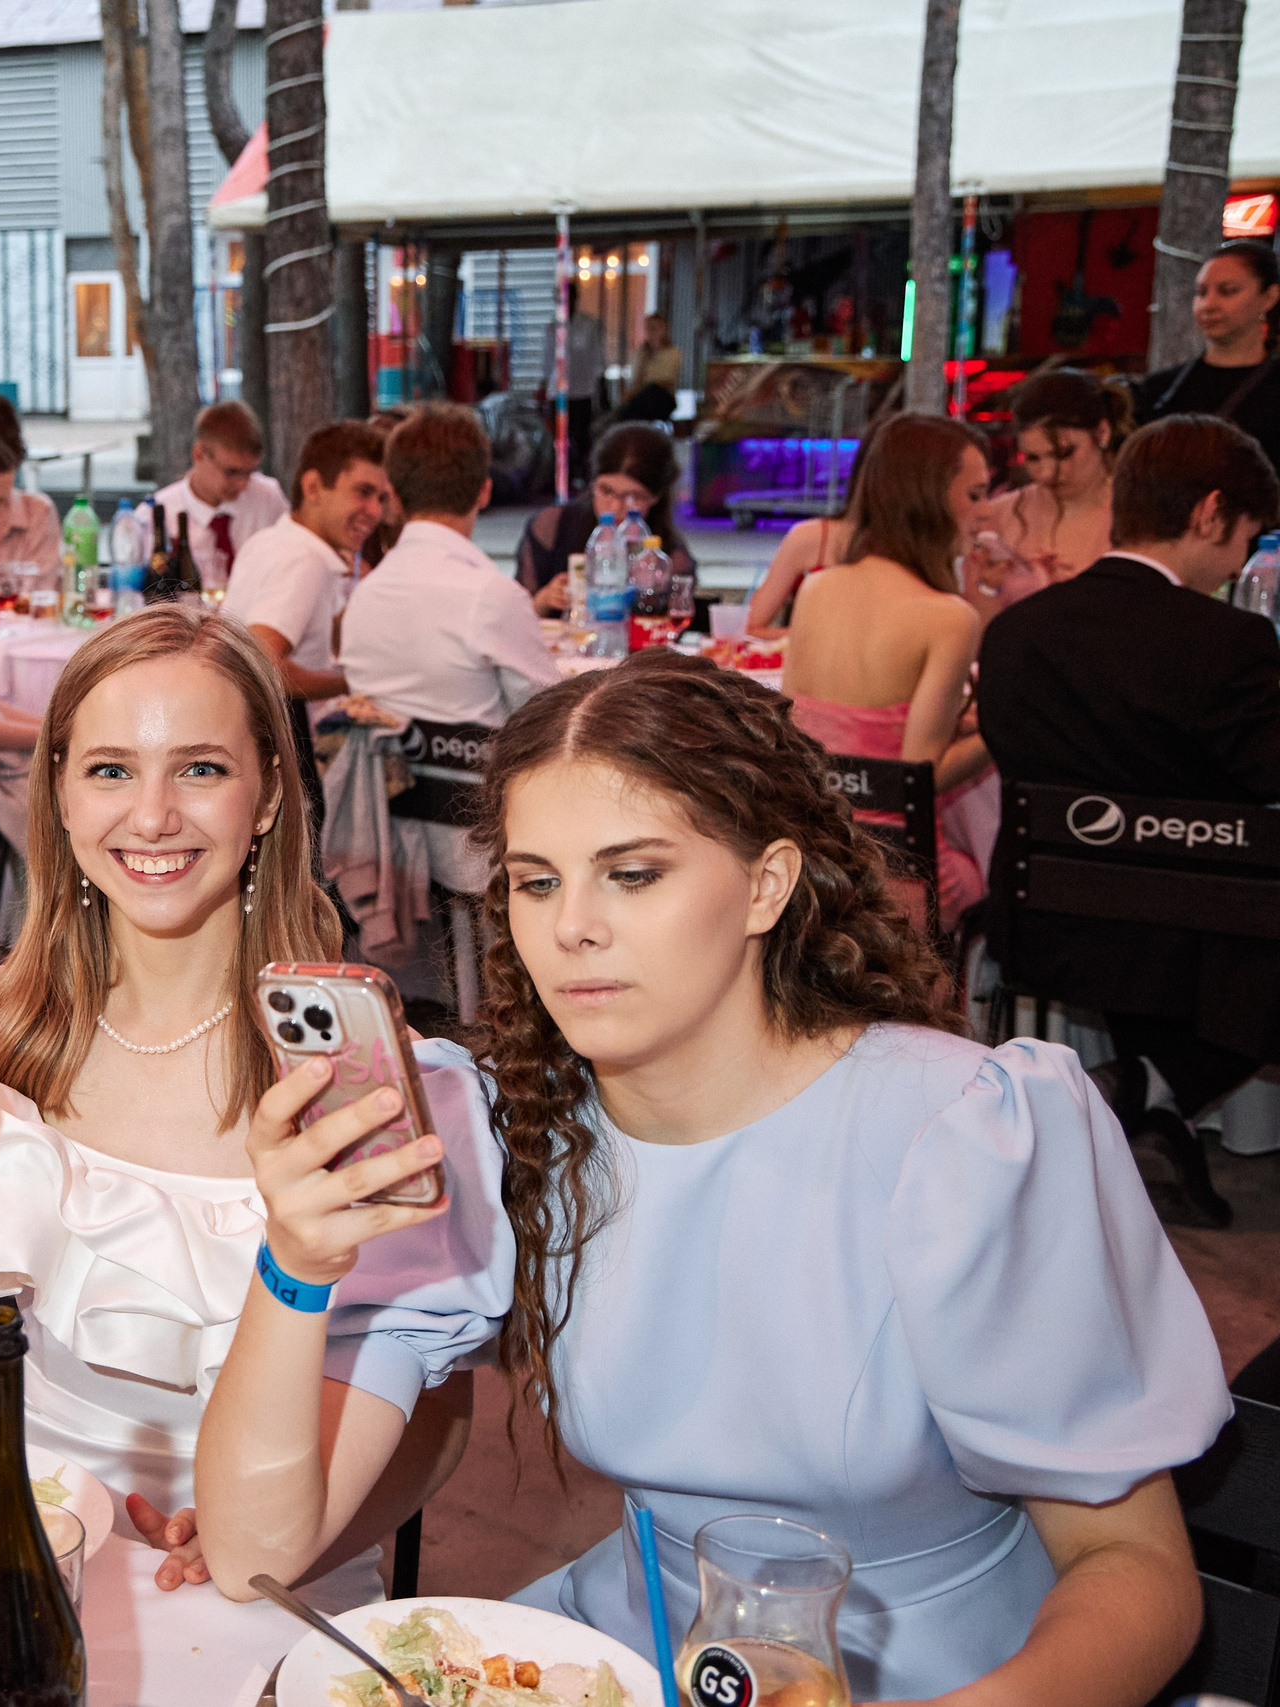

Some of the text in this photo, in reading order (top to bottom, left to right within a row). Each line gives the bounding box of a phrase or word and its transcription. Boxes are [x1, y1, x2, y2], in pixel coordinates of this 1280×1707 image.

[431, 735, 492, 765] pep
[824, 770, 870, 796] psi
[1133, 814, 1246, 848] pepsi
[699, 1665, 740, 1704] GS
